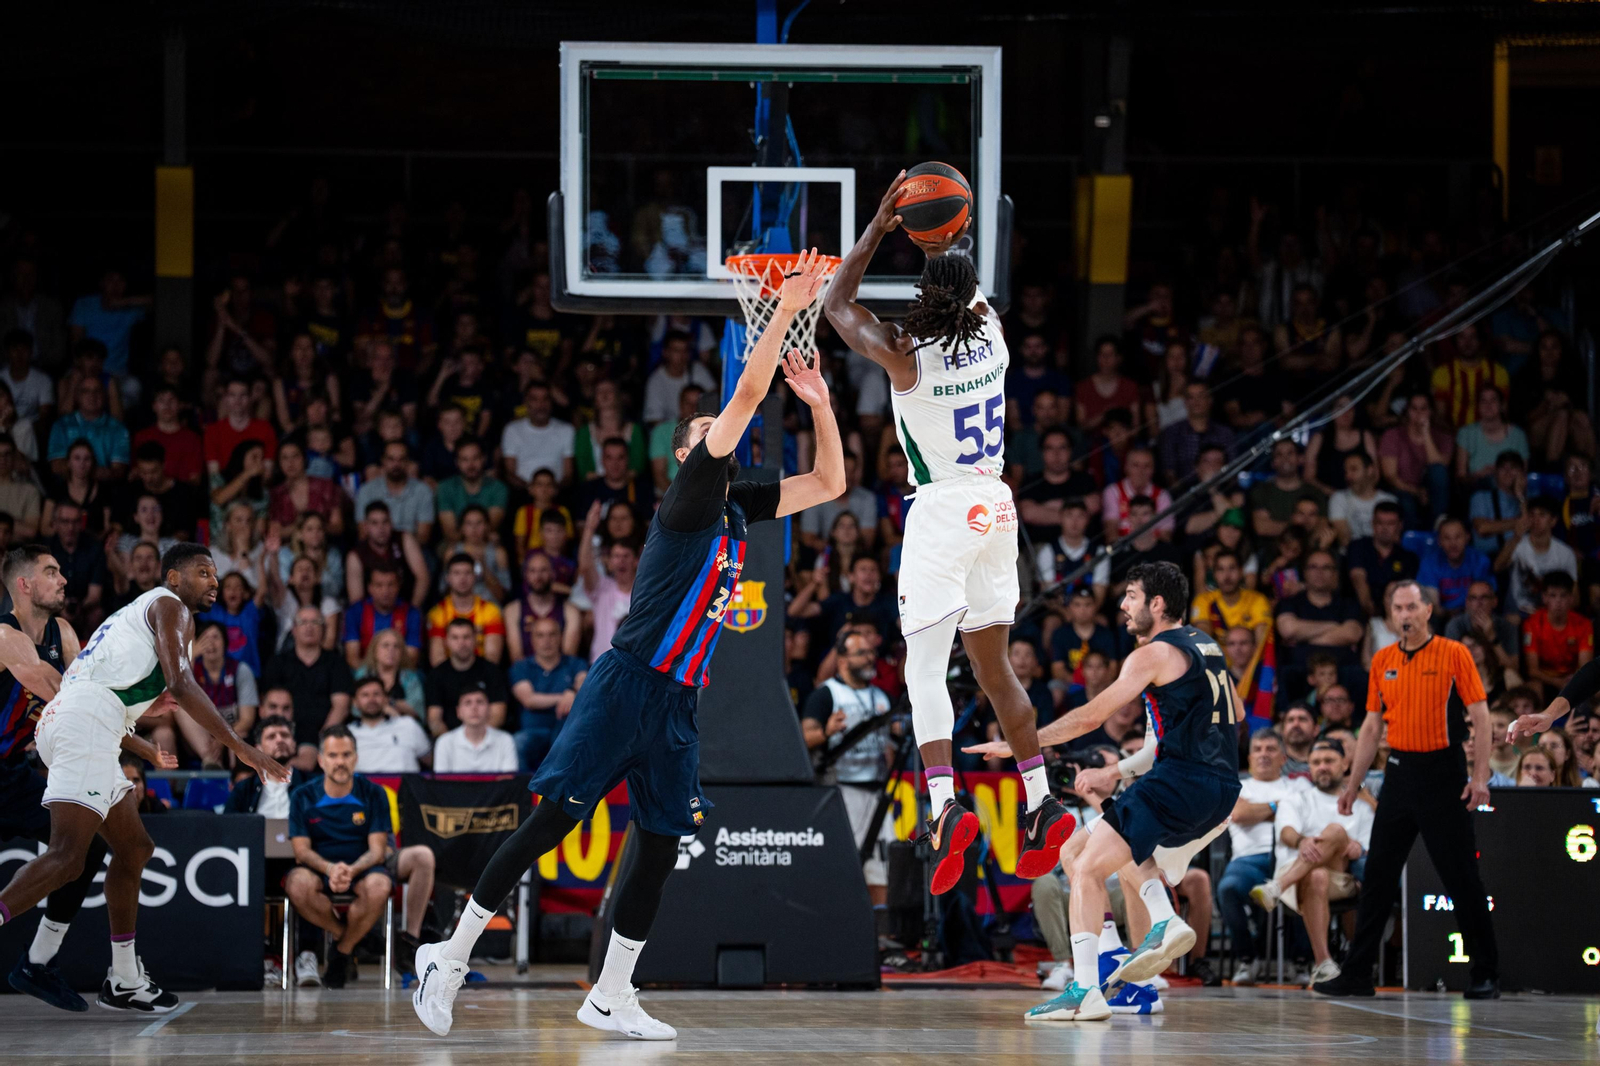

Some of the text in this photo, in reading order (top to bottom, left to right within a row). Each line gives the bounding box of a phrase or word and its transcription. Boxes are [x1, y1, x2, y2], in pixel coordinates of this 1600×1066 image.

[942, 341, 994, 371] PERRY
[953, 392, 1004, 466] 55
[996, 513, 1010, 524] DEL
[1204, 668, 1236, 725] 21
[715, 827, 825, 846] Assistencia
[1565, 824, 1597, 862] 6
[715, 847, 792, 866] Sanitària
[1448, 932, 1470, 963] 1
